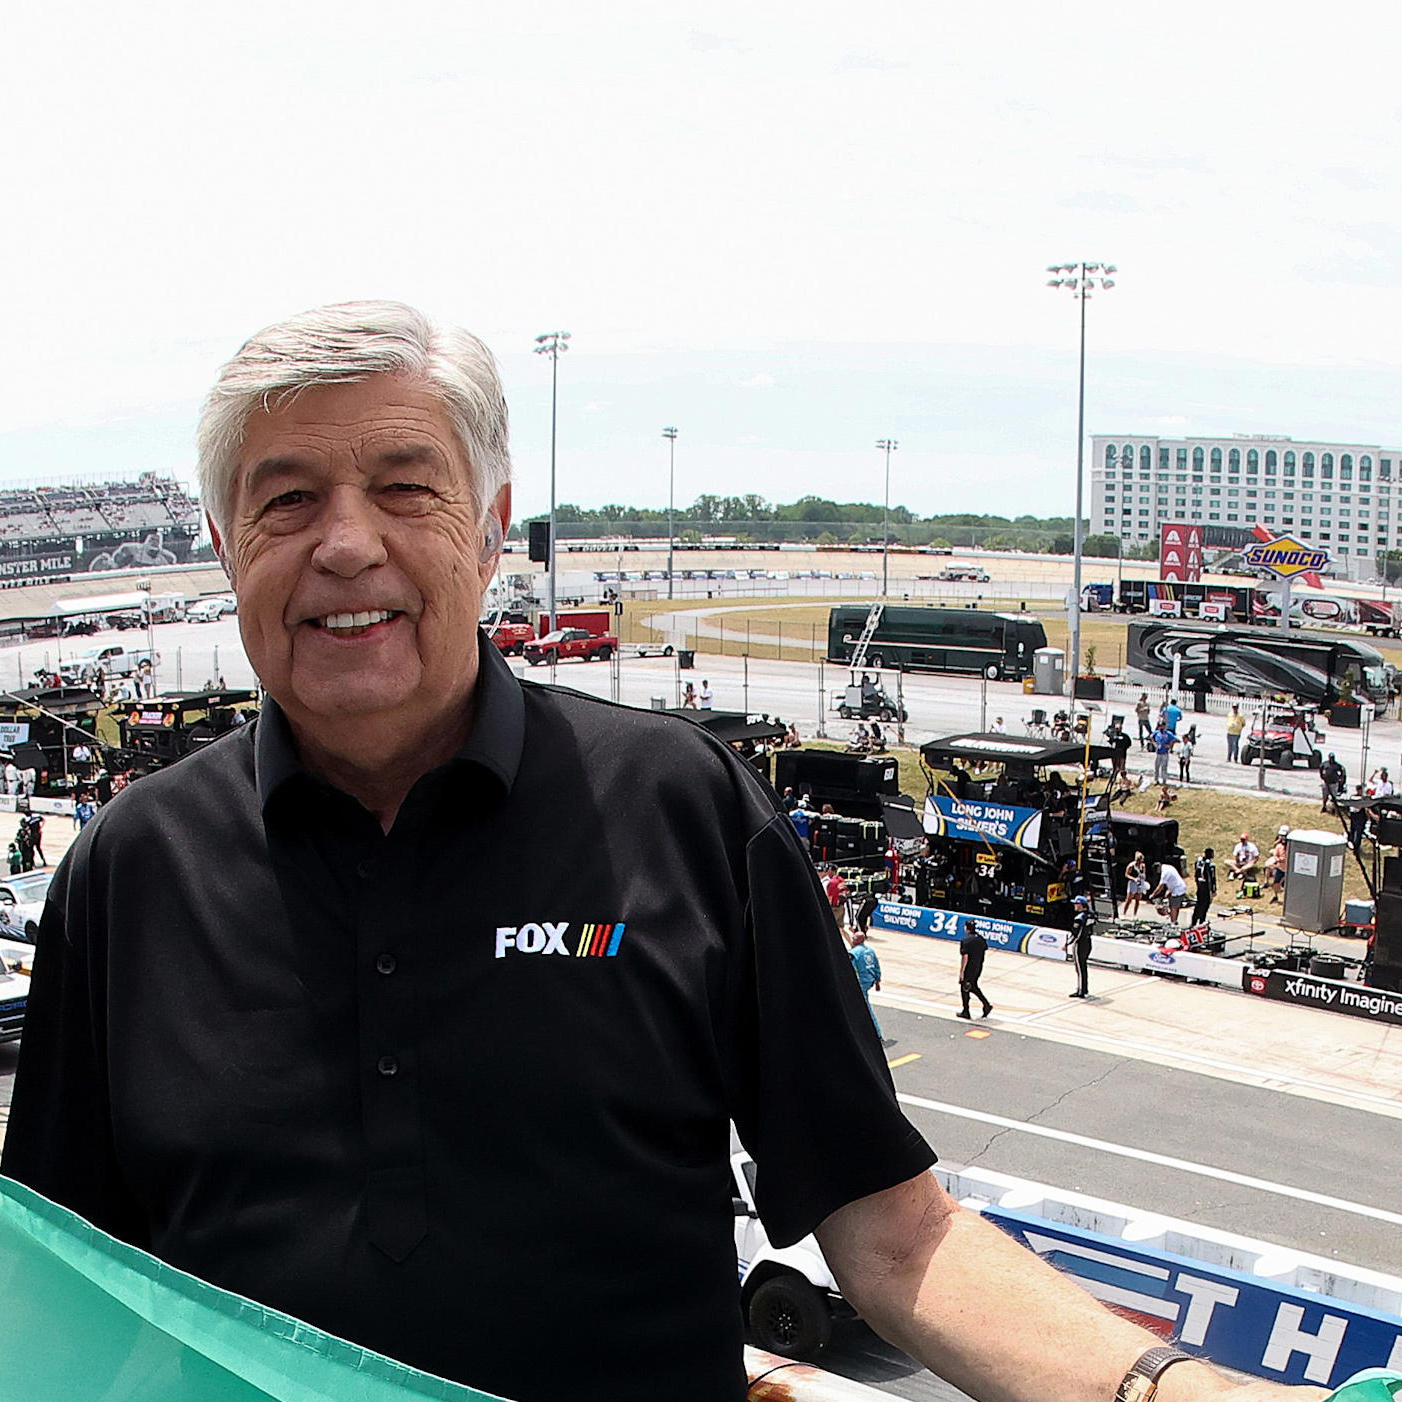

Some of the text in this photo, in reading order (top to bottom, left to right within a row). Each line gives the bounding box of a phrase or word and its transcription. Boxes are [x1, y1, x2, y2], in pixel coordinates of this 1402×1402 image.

[40, 556, 72, 570] MILE
[1250, 549, 1325, 567] SUNOCO
[951, 803, 1015, 823] LONG JOHN
[978, 864, 995, 879] 34
[879, 904, 922, 919] LONG JOHN
[929, 911, 958, 936] 34
[992, 922, 1014, 935] JOHN
[494, 922, 571, 958] FOX
[1153, 952, 1174, 964] Ford
[1284, 979, 1338, 1004] xfinity
